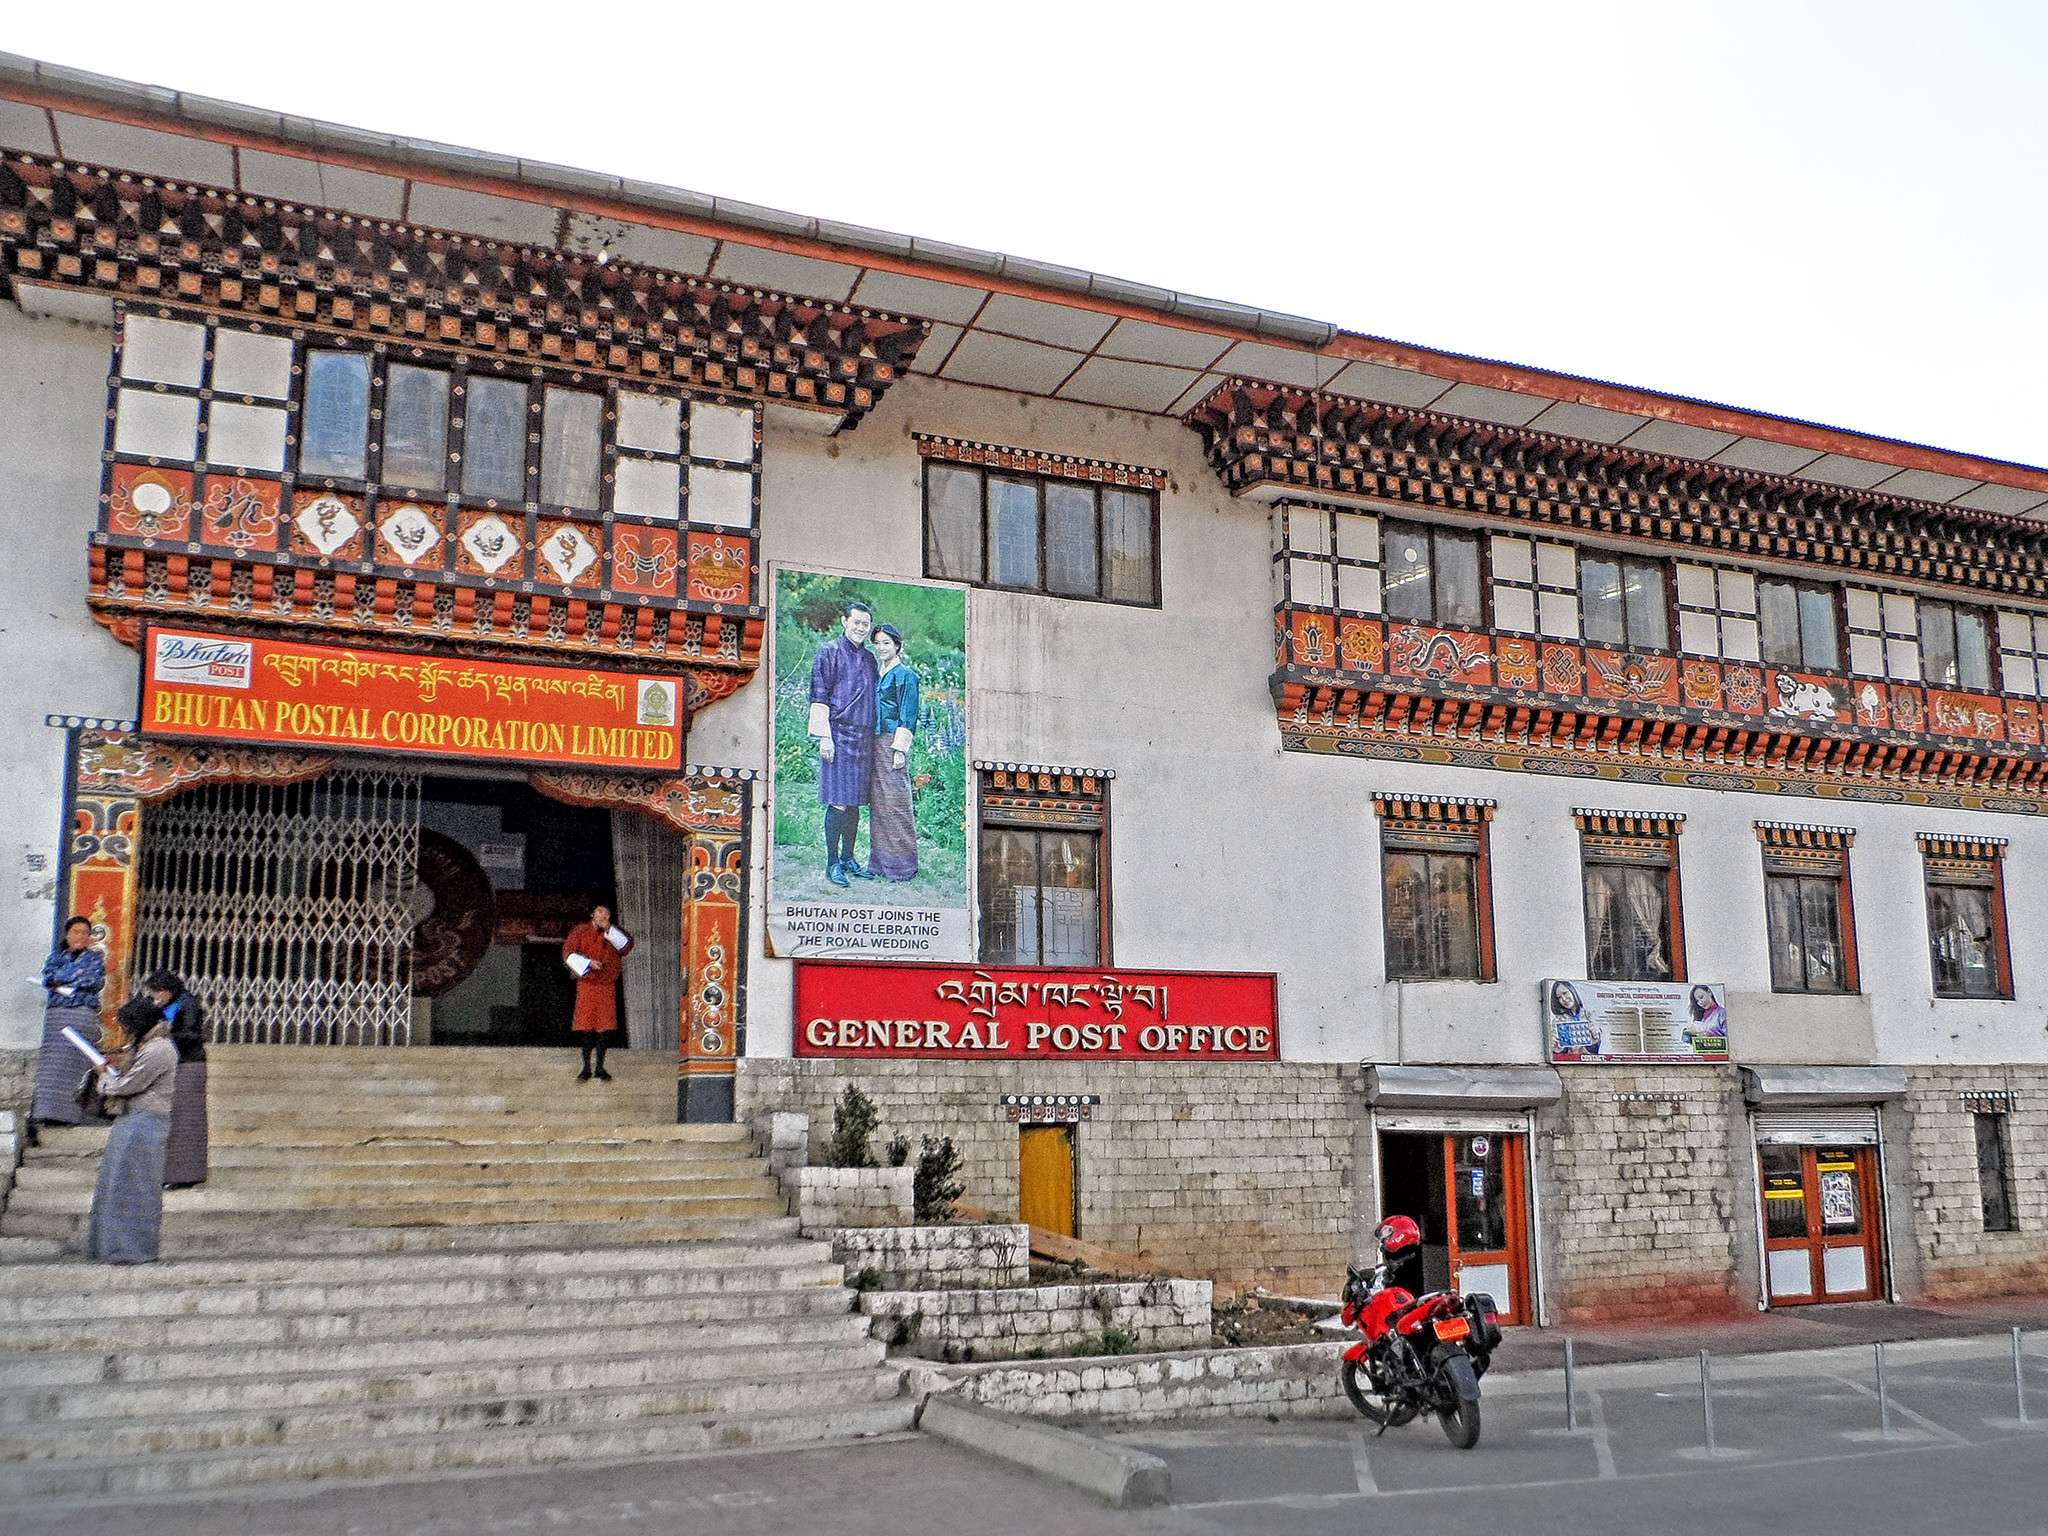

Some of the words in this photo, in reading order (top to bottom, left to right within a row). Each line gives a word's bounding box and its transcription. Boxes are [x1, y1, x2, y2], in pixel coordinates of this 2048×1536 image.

[158, 638, 249, 664] Bhutan
[211, 664, 243, 677] POST
[153, 690, 269, 731] BHUTAN
[273, 701, 377, 740] POSTAL
[381, 710, 564, 754] CORPORATION
[570, 725, 675, 760] LIMITED
[786, 906, 838, 919] BHUTAN
[841, 908, 874, 920] POST
[877, 910, 914, 921] JOINS
[917, 911, 941, 923] THE
[787, 921, 834, 933] NATION
[837, 923, 850, 933] IN
[853, 923, 940, 936] CELEBRATING
[798, 935, 822, 946] THE
[825, 936, 869, 948] ROYAL
[871, 938, 929, 950] WEDDING
[806, 1019, 1010, 1050] GENERAL
[1027, 1022, 1128, 1051] POST
[1140, 1025, 1272, 1053] OFFICE
